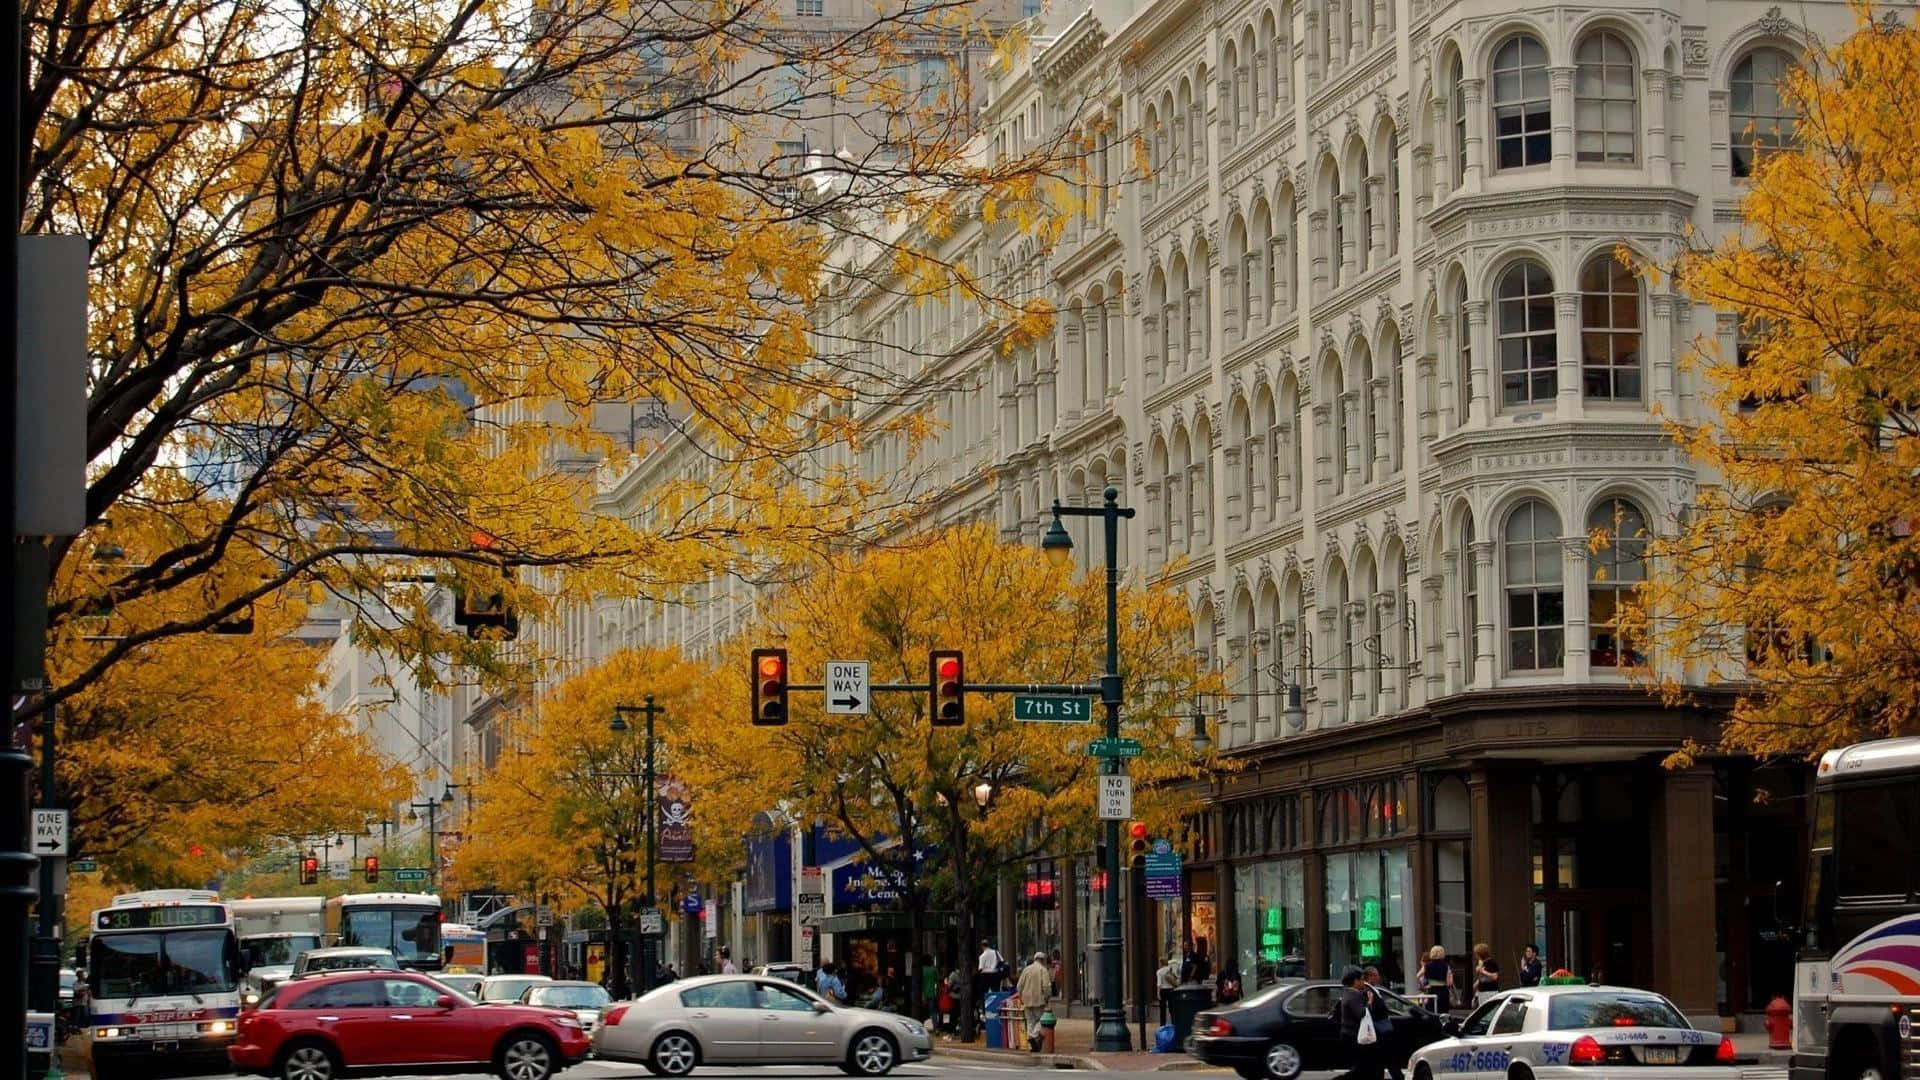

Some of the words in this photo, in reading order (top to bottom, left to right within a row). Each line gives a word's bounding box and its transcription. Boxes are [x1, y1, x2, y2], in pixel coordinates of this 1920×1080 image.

[834, 667, 861, 678] ONE
[833, 680, 862, 692] WAY
[1025, 701, 1053, 714] 7th
[1062, 702, 1080, 714] St
[1108, 780, 1122, 788] NO
[38, 814, 62, 824] ONE
[37, 826, 62, 836] WAY
